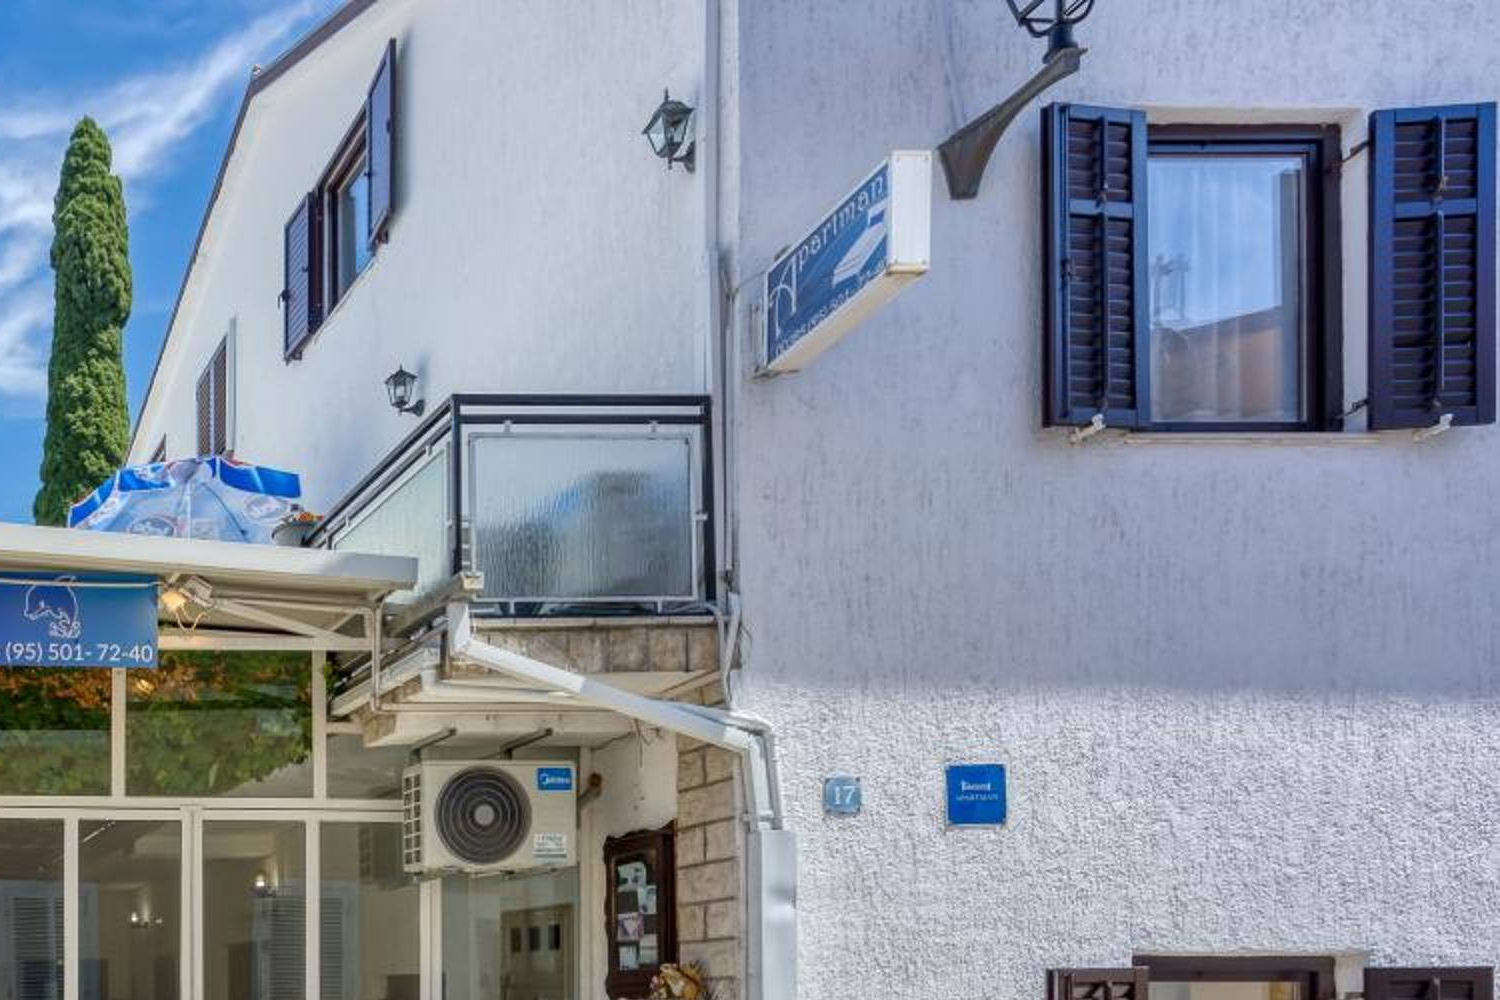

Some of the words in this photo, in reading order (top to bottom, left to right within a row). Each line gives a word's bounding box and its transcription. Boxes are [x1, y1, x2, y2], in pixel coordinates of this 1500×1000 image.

[5, 642, 44, 662] (95)
[48, 643, 92, 662] 501-
[98, 643, 154, 663] 72-40
[835, 785, 856, 806] 17
